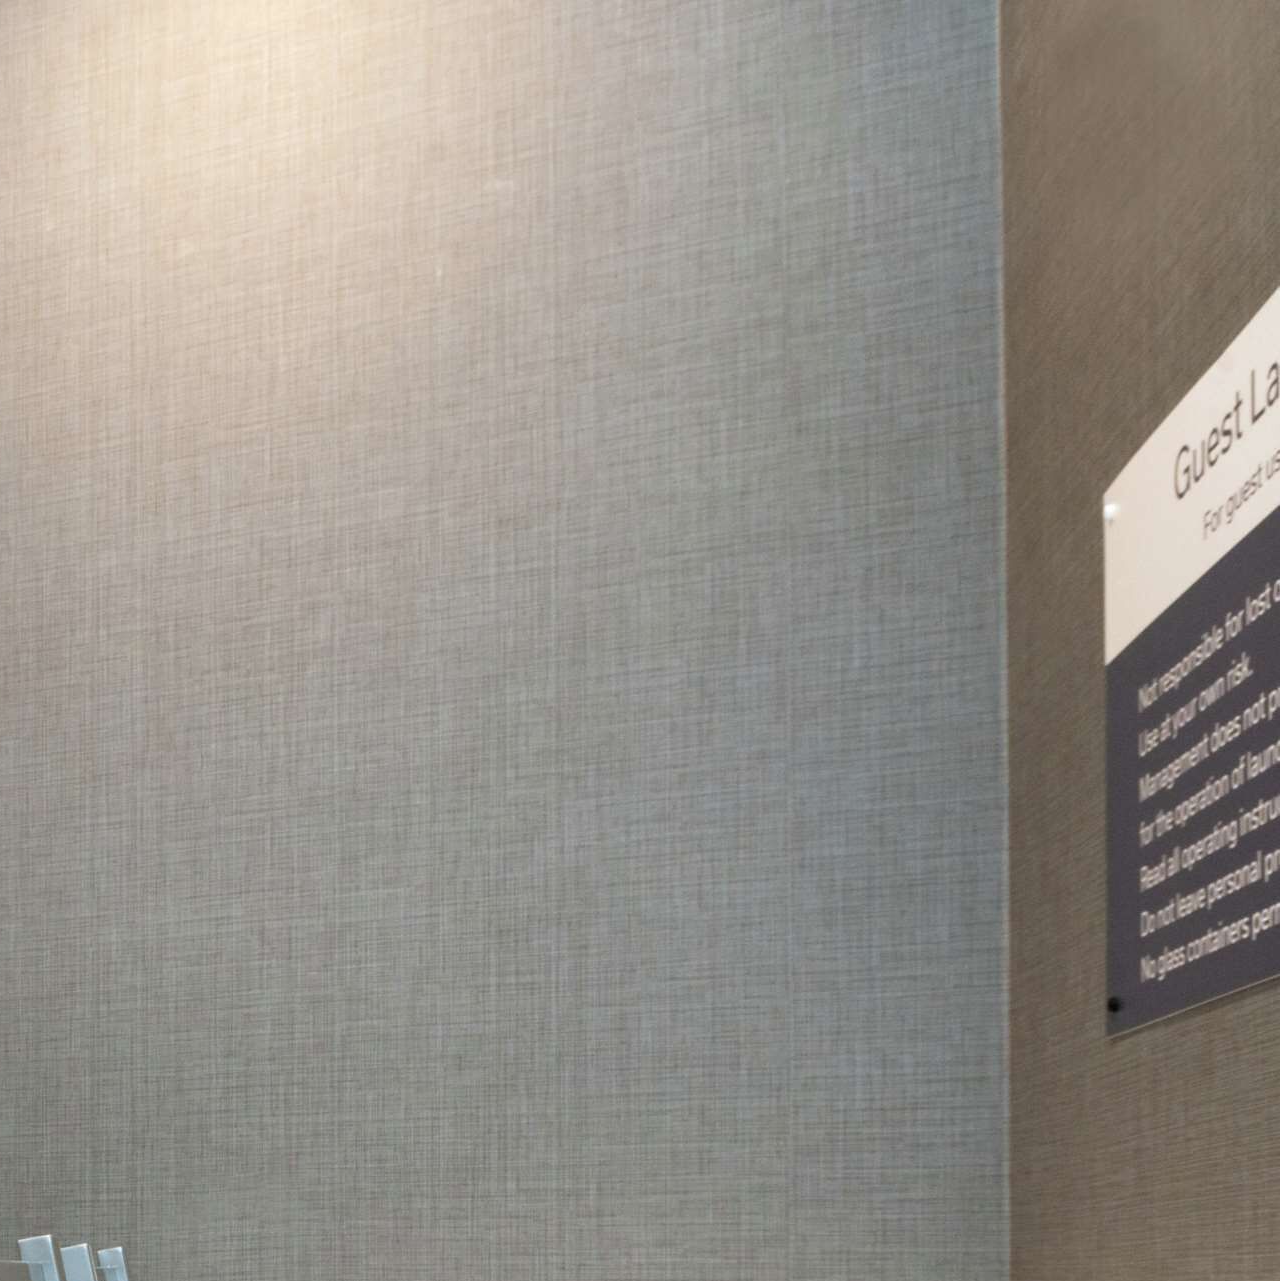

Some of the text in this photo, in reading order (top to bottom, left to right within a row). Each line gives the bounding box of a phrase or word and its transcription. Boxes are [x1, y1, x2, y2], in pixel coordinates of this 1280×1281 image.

[1174, 391, 1243, 499] Guest
[1203, 504, 1224, 540] For
[1225, 463, 1263, 525] guest
[1158, 624, 1224, 696] responsible
[1225, 611, 1244, 641] for
[1245, 582, 1271, 626] lost
[1138, 728, 1160, 758] Use
[1171, 698, 1197, 739] your
[1198, 677, 1225, 712] own
[1227, 652, 1254, 691] risk.
[1138, 733, 1209, 802] Management
[1209, 722, 1241, 752] does
[1242, 692, 1266, 730] not
[1174, 776, 1230, 827] operation
[1231, 755, 1245, 789] of
[1181, 820, 1238, 870] operating
[1176, 893, 1206, 919] leave
[1206, 850, 1262, 910] personal
[1157, 946, 1186, 981] glass
[1186, 917, 1250, 962] containers
